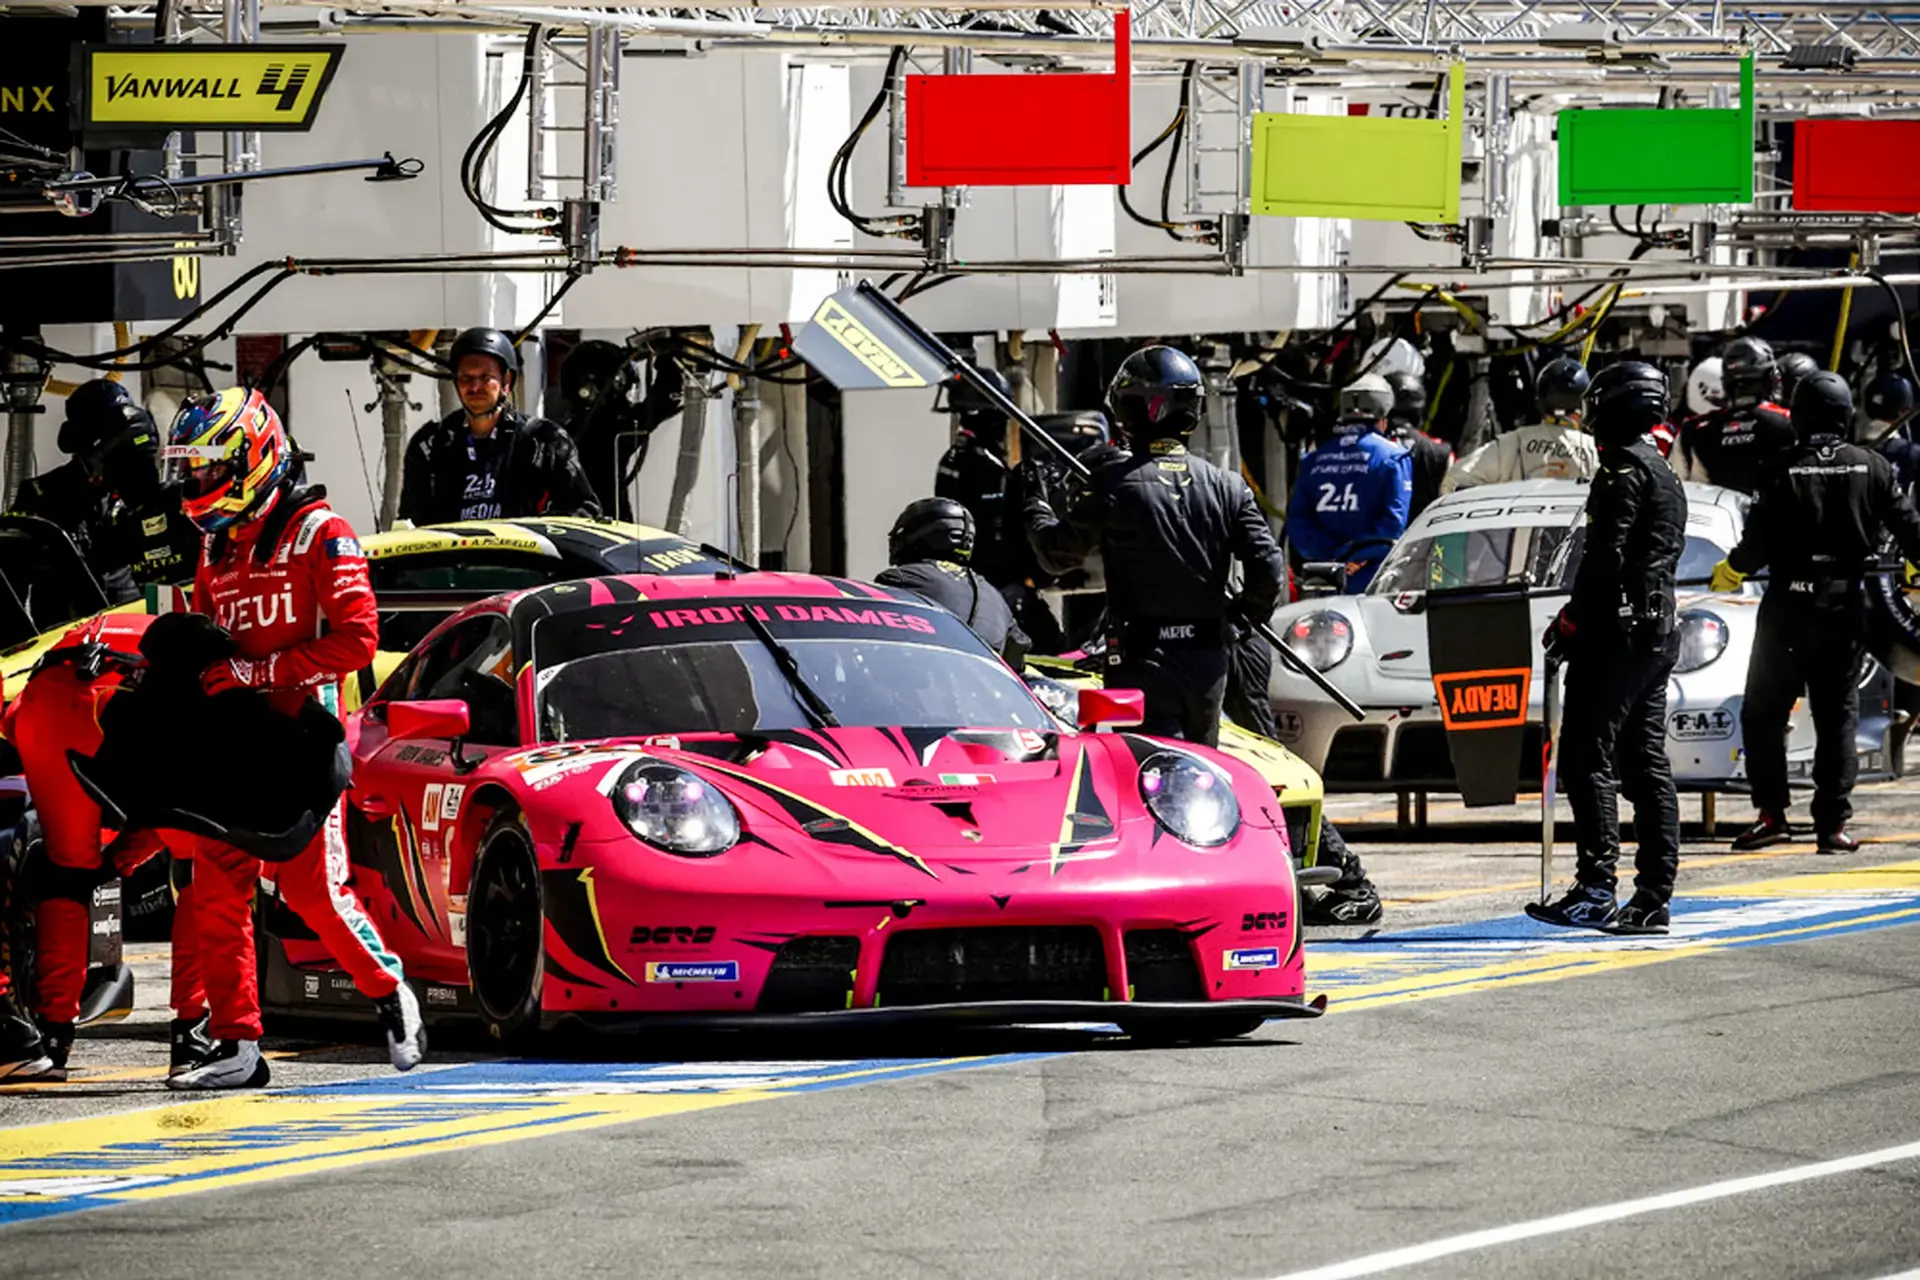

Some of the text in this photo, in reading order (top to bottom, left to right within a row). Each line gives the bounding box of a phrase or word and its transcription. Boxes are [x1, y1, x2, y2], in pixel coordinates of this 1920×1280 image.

[105, 63, 312, 111] VANWALL 4
[460, 503, 502, 521] MEDIA
[648, 604, 937, 635] IRON DAMES
[1451, 683, 1517, 715] READY
[671, 966, 728, 976] MICHELIN
